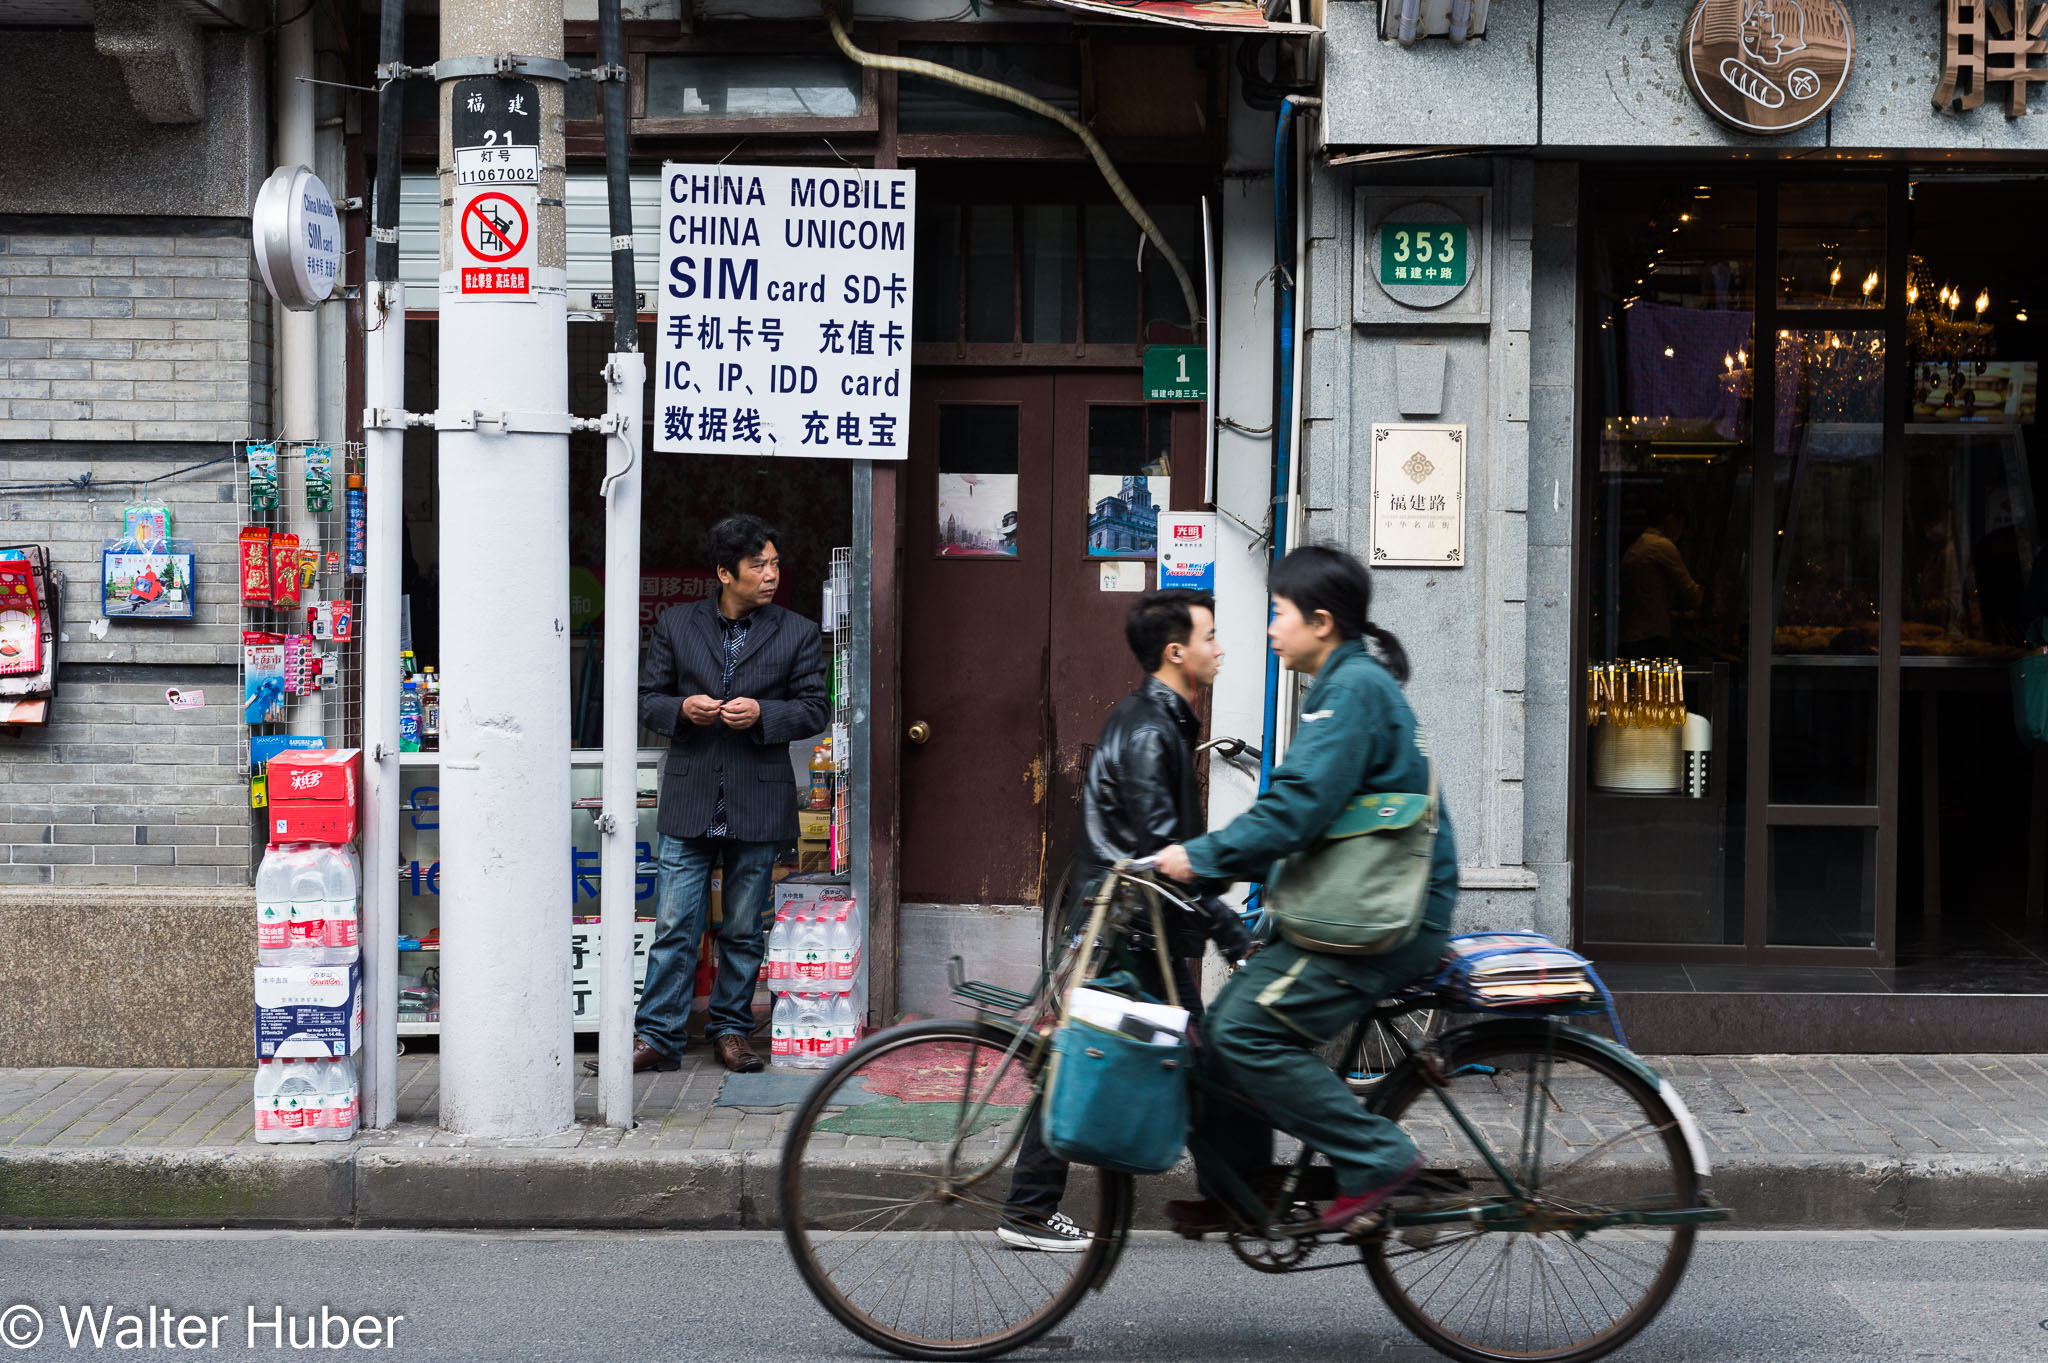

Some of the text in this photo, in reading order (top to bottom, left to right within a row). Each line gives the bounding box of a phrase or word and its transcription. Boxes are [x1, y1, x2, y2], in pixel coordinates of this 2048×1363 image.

[483, 129, 514, 147] 21
[481, 149, 511, 163] 灯号
[461, 168, 535, 183] 11067002
[670, 173, 906, 210] CHINA MOBILE
[308, 222, 323, 251] SIM
[669, 214, 761, 247] CHINA
[784, 218, 905, 251] UNICOM
[1393, 230, 1455, 263] 353
[465, 273, 493, 289] 禁止攀登
[495, 273, 525, 289] 高压危险
[668, 255, 759, 301] SIM
[767, 274, 826, 303] card
[843, 272, 907, 309] SD卡
[1394, 266, 1453, 279] 福建中路
[666, 314, 905, 357] 手机卡号 充值卡
[770, 364, 818, 394] IDD
[841, 368, 899, 397] card
[1175, 354, 1190, 383] 1
[800, 409, 898, 447] 充电宝
[1390, 493, 1446, 512] 福建路
[1176, 526, 1200, 536] 光明
